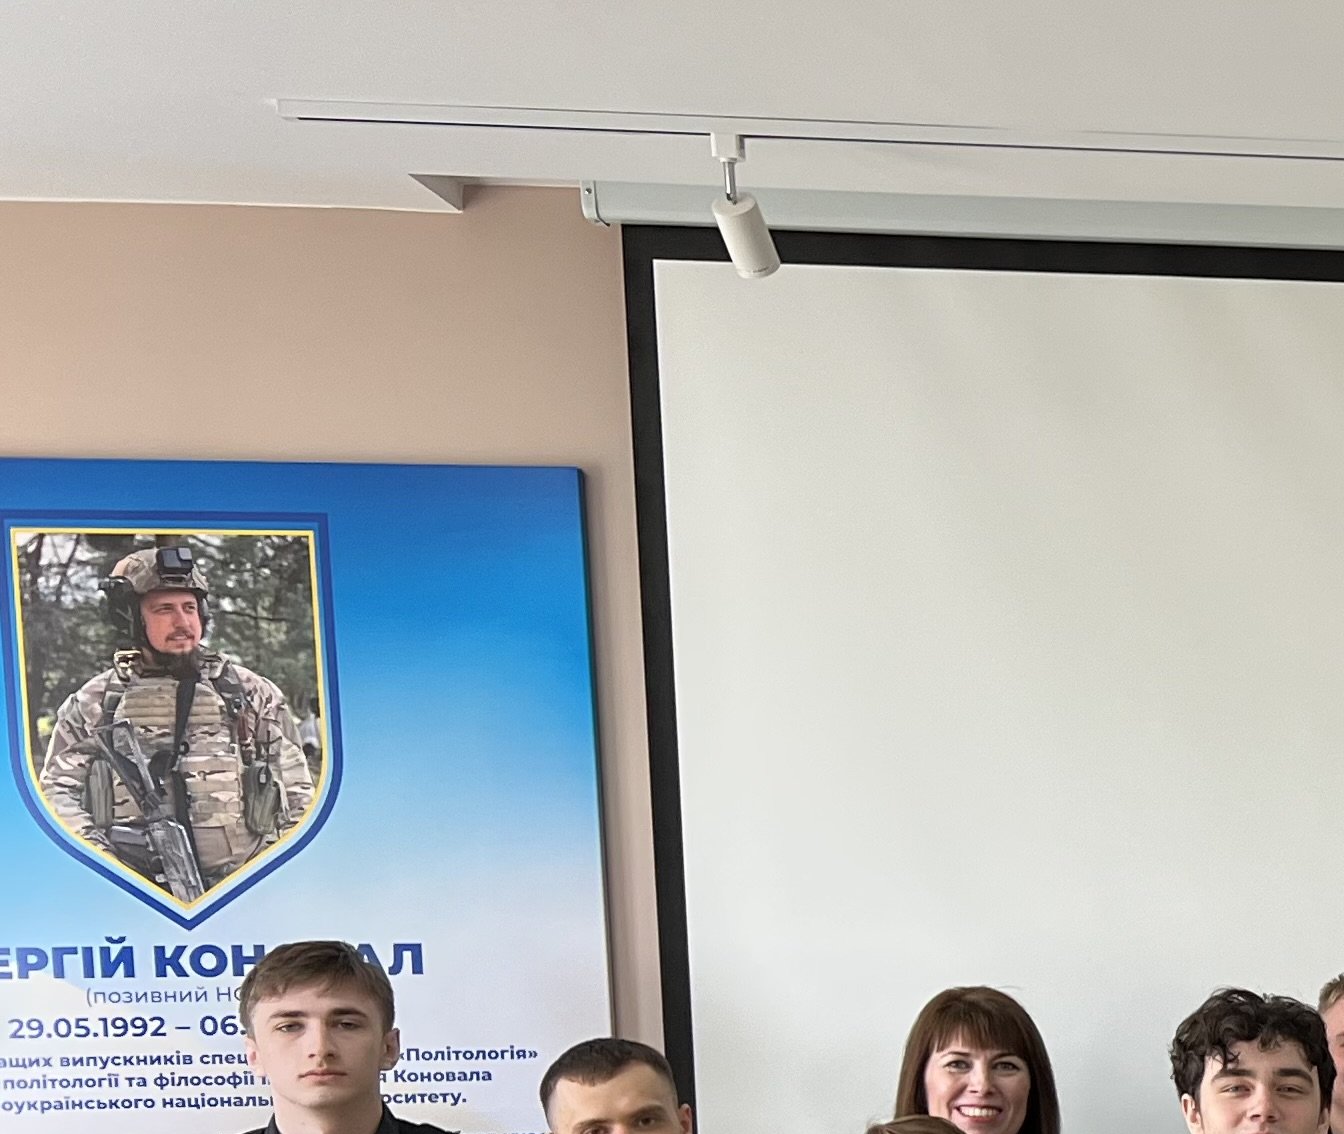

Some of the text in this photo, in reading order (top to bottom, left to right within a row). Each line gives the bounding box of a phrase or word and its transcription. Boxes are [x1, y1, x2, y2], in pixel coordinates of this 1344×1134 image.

[154, 943, 424, 978] КОНАЛ
[86, 986, 208, 1007] (позивний
[8, 1016, 168, 1039] 29.05.1992
[200, 1014, 247, 1036] 06.
[59, 1050, 193, 1071] випускників
[200, 1053, 249, 1067] спец
[3, 1073, 120, 1090] політології
[126, 1077, 148, 1088] та
[154, 1071, 255, 1090] філософії
[393, 1070, 492, 1083] Коновала
[162, 1093, 274, 1109] національ
